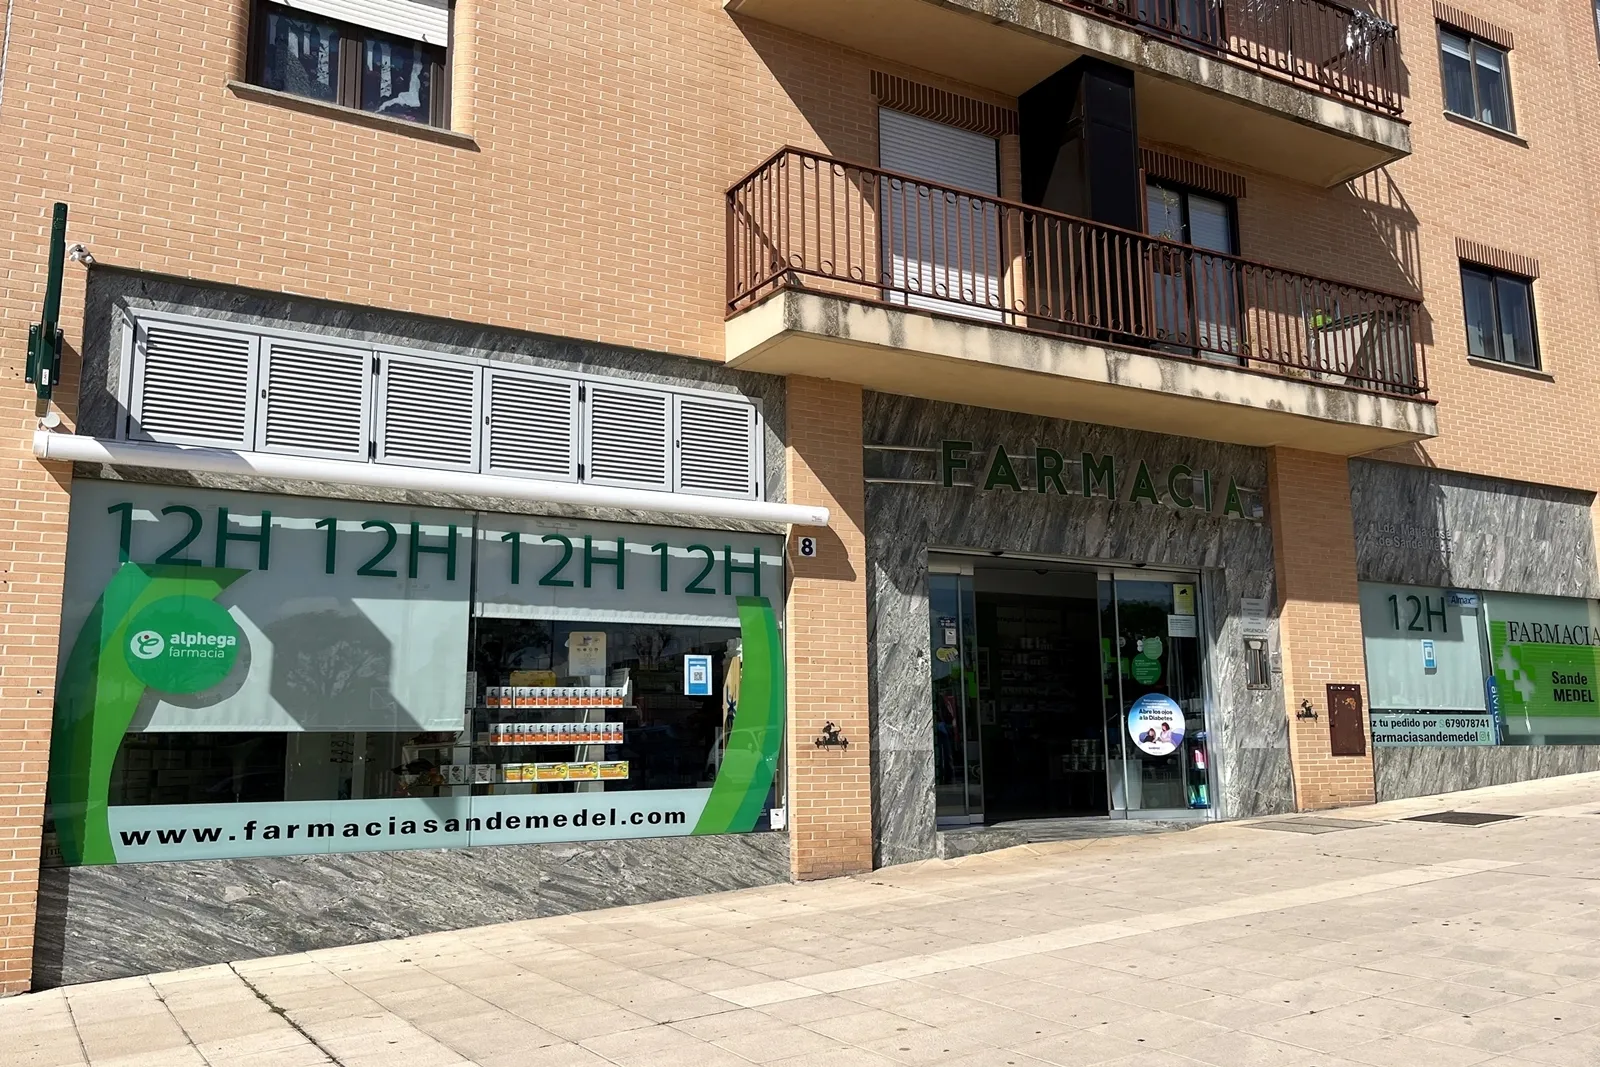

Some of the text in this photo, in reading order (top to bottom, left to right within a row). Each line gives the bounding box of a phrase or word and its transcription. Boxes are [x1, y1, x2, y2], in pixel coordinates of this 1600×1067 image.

[941, 439, 1245, 519] FARMACIA
[107, 502, 761, 597] 12H 12H 12H 12H
[801, 538, 813, 556] 8
[1389, 594, 1447, 633] 12H
[170, 632, 236, 648] alphega
[1507, 621, 1600, 646] FARMACIA
[169, 646, 225, 658] farmacia
[1552, 671, 1588, 685] Sande
[1553, 689, 1595, 702] MEDEL
[1379, 719, 1389, 728] tu
[1391, 718, 1420, 729] pedido
[1423, 719, 1437, 729] por
[1445, 719, 1490, 728] 679078741
[1371, 731, 1479, 742] farmaciasandemedel
[120, 808, 686, 845] www.farmaciasandemedel.com
